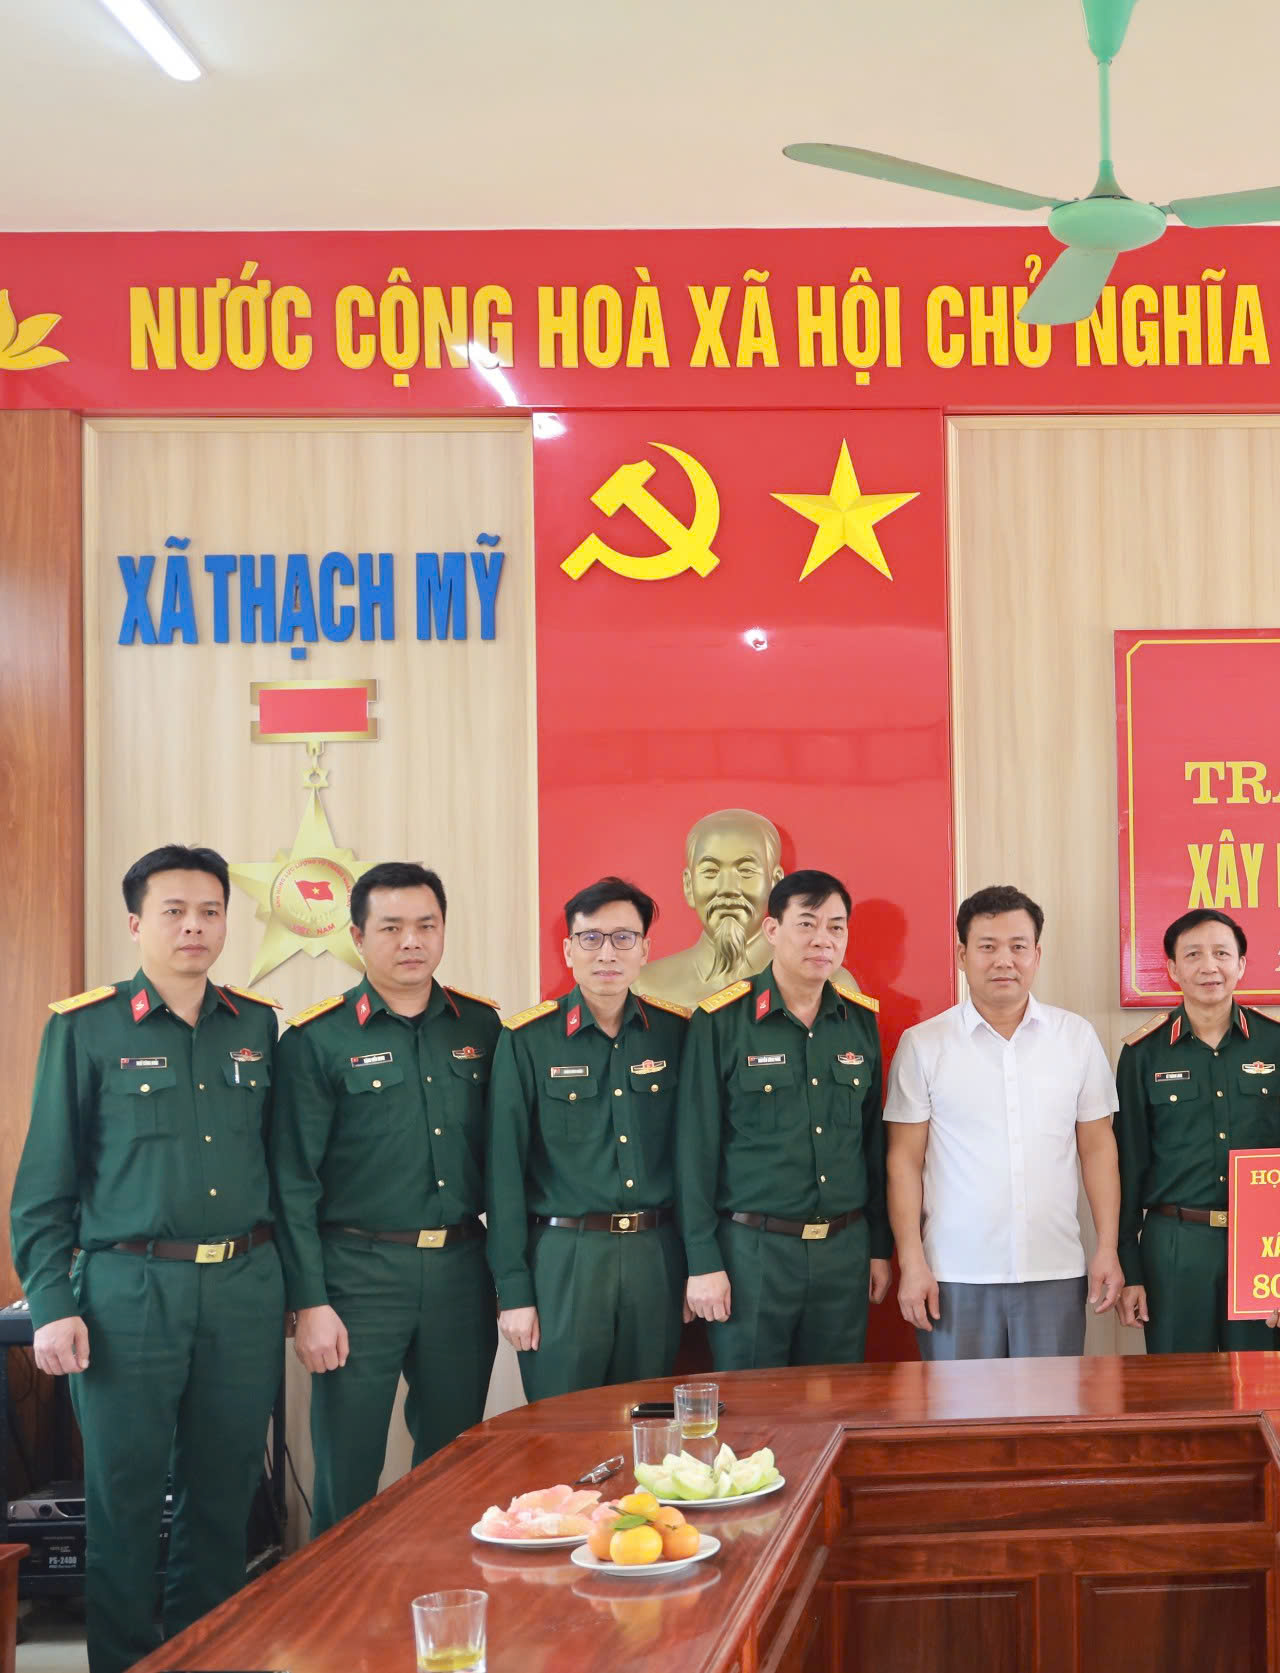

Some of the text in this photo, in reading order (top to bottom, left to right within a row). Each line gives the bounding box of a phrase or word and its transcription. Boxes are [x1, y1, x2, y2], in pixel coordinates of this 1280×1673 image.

[130, 262, 312, 370] NƯỚC
[336, 268, 512, 387] CỘNG
[539, 267, 669, 368] HOÀ
[688, 269, 779, 367] XÃ
[798, 267, 901, 385] HỘI
[1076, 268, 1270, 367] NGHĨA
[118, 533, 504, 660] XÃ THẠCH MỸ
[1187, 828, 1265, 909] XÂY
